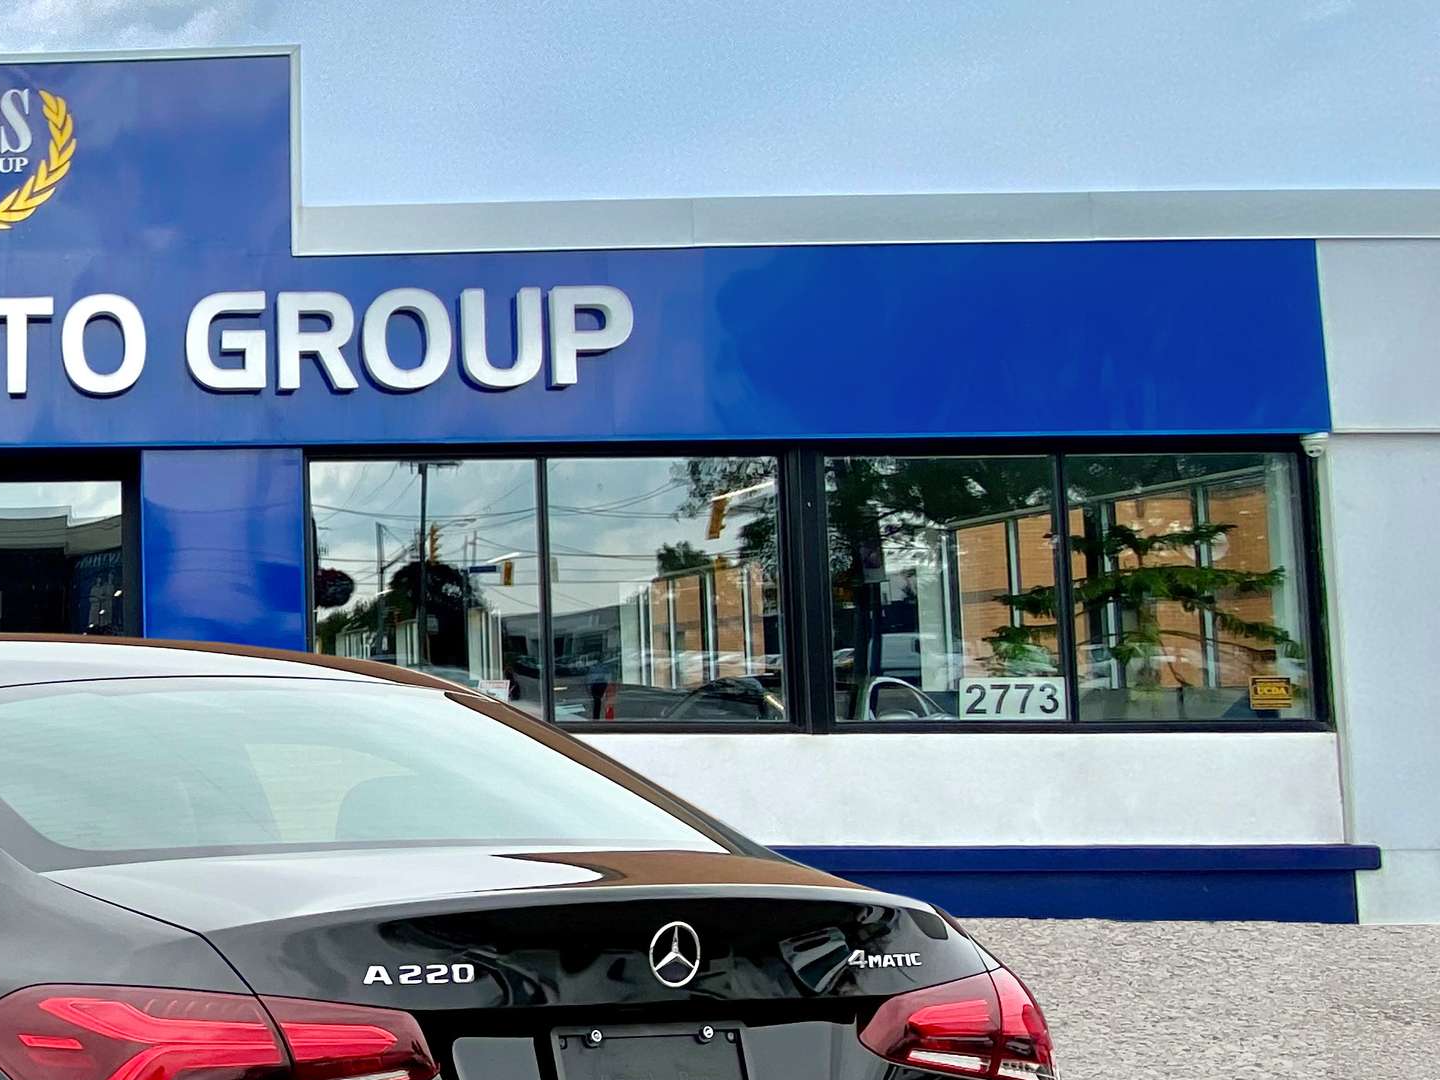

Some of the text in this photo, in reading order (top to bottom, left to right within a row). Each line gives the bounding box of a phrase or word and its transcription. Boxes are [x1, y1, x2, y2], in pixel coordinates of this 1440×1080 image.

[184, 285, 636, 394] GROUP
[964, 683, 1060, 715] 2773
[847, 949, 923, 969] 4MATIC
[362, 963, 476, 985] A 220
